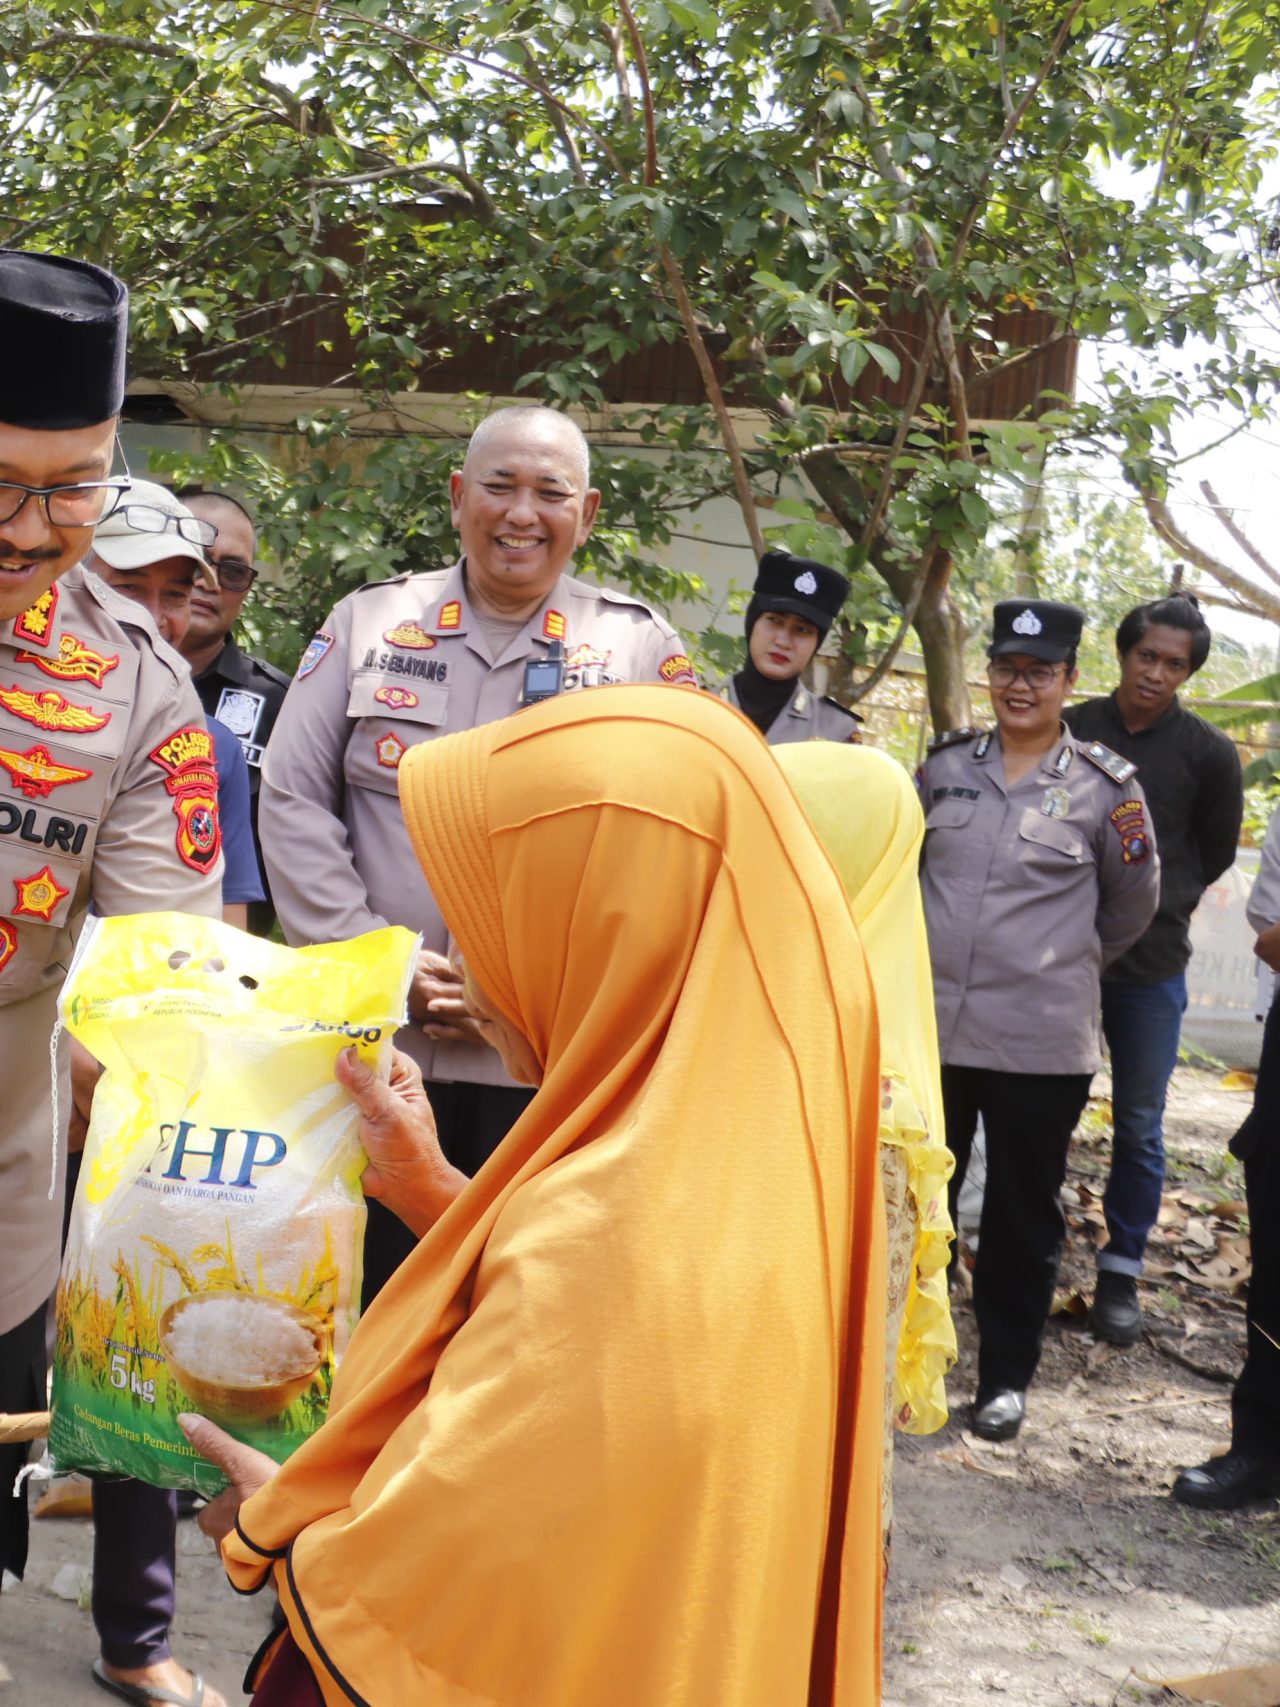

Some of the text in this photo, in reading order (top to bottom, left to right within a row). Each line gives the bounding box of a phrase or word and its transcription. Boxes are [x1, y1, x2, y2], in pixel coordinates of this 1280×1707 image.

[162, 1184, 183, 1195] DAN
[183, 1186, 216, 1201] HARGA
[216, 1190, 256, 1205] PANGAN
[110, 1353, 156, 1404] 5 kg
[73, 1403, 113, 1432] Cadangan
[114, 1421, 141, 1443] Beras
